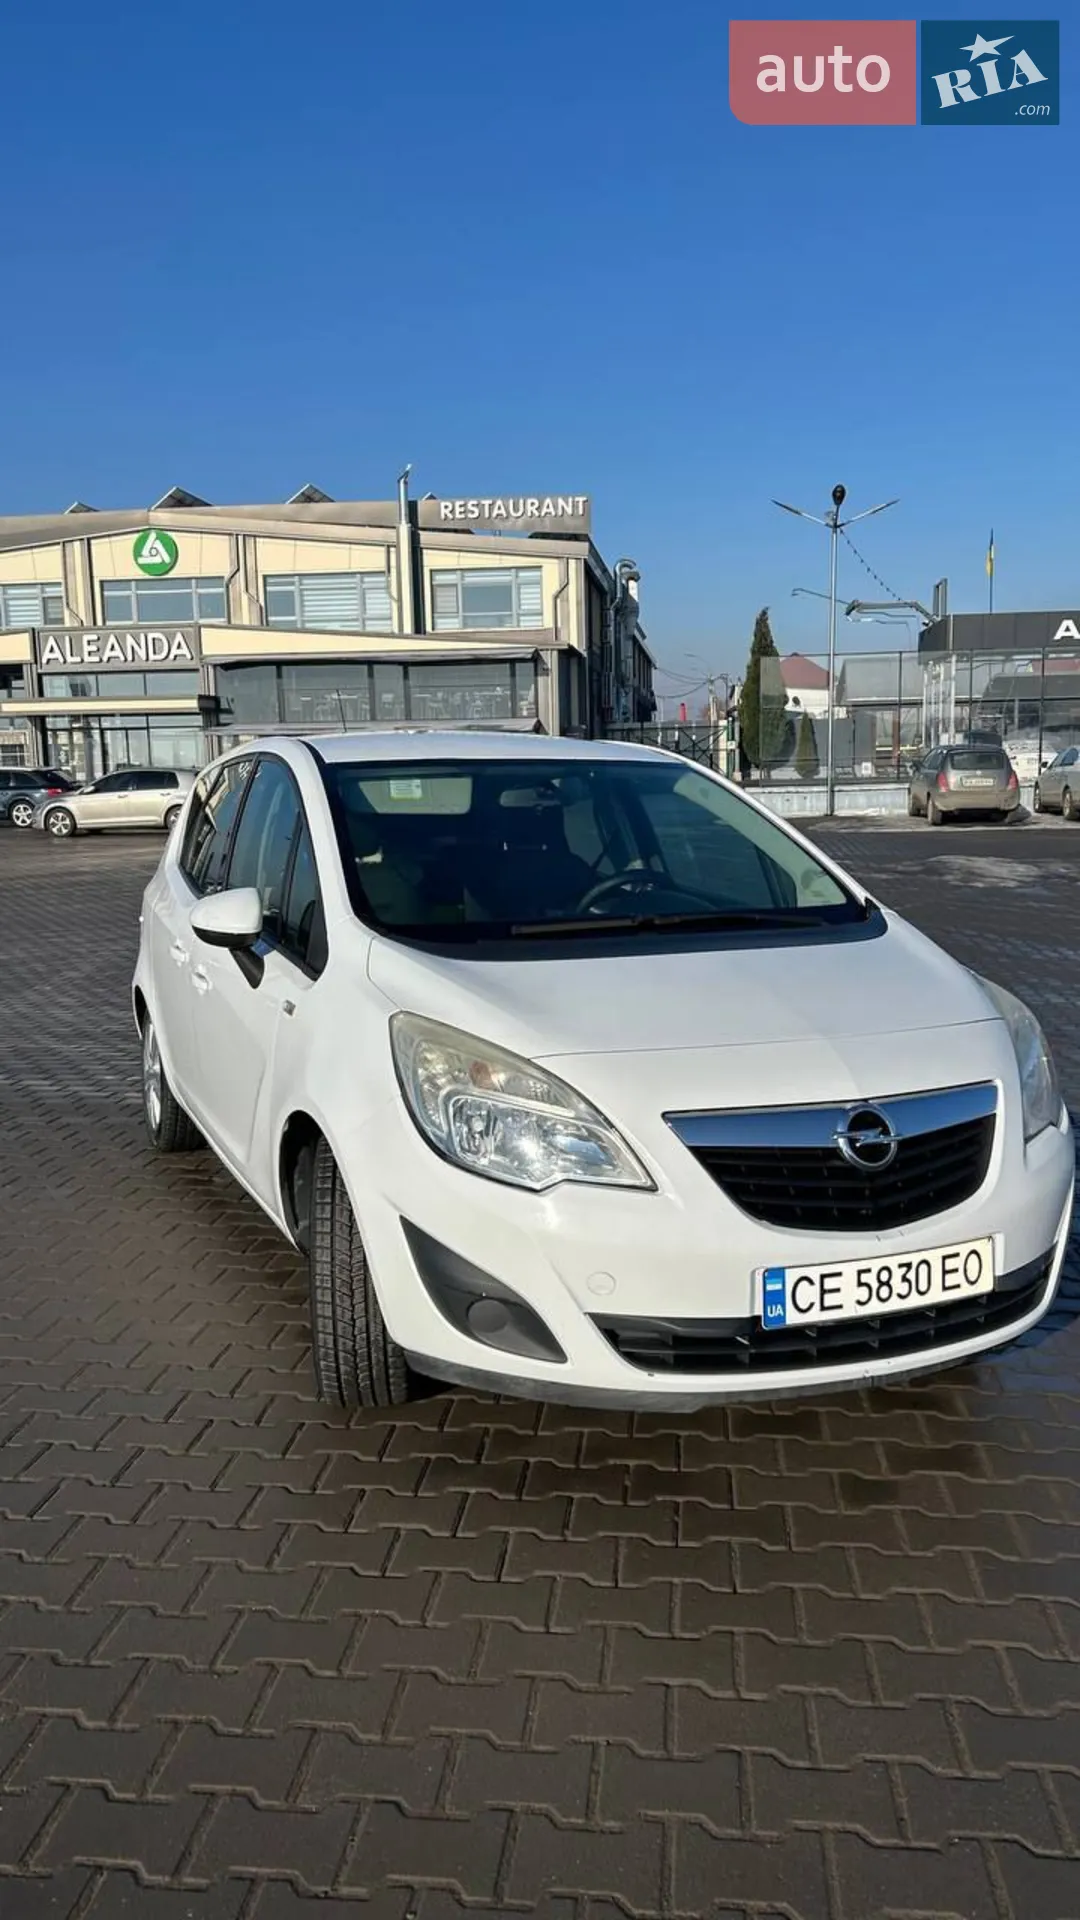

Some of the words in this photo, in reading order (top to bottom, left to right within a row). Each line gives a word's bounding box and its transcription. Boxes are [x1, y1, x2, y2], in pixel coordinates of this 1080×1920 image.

[440, 496, 589, 520] RESTAURANT
[41, 631, 194, 665] ALEANDA
[791, 1271, 843, 1314] CE
[855, 1259, 932, 1306] 5830
[941, 1248, 983, 1293] EO
[767, 1304, 784, 1318] UA
